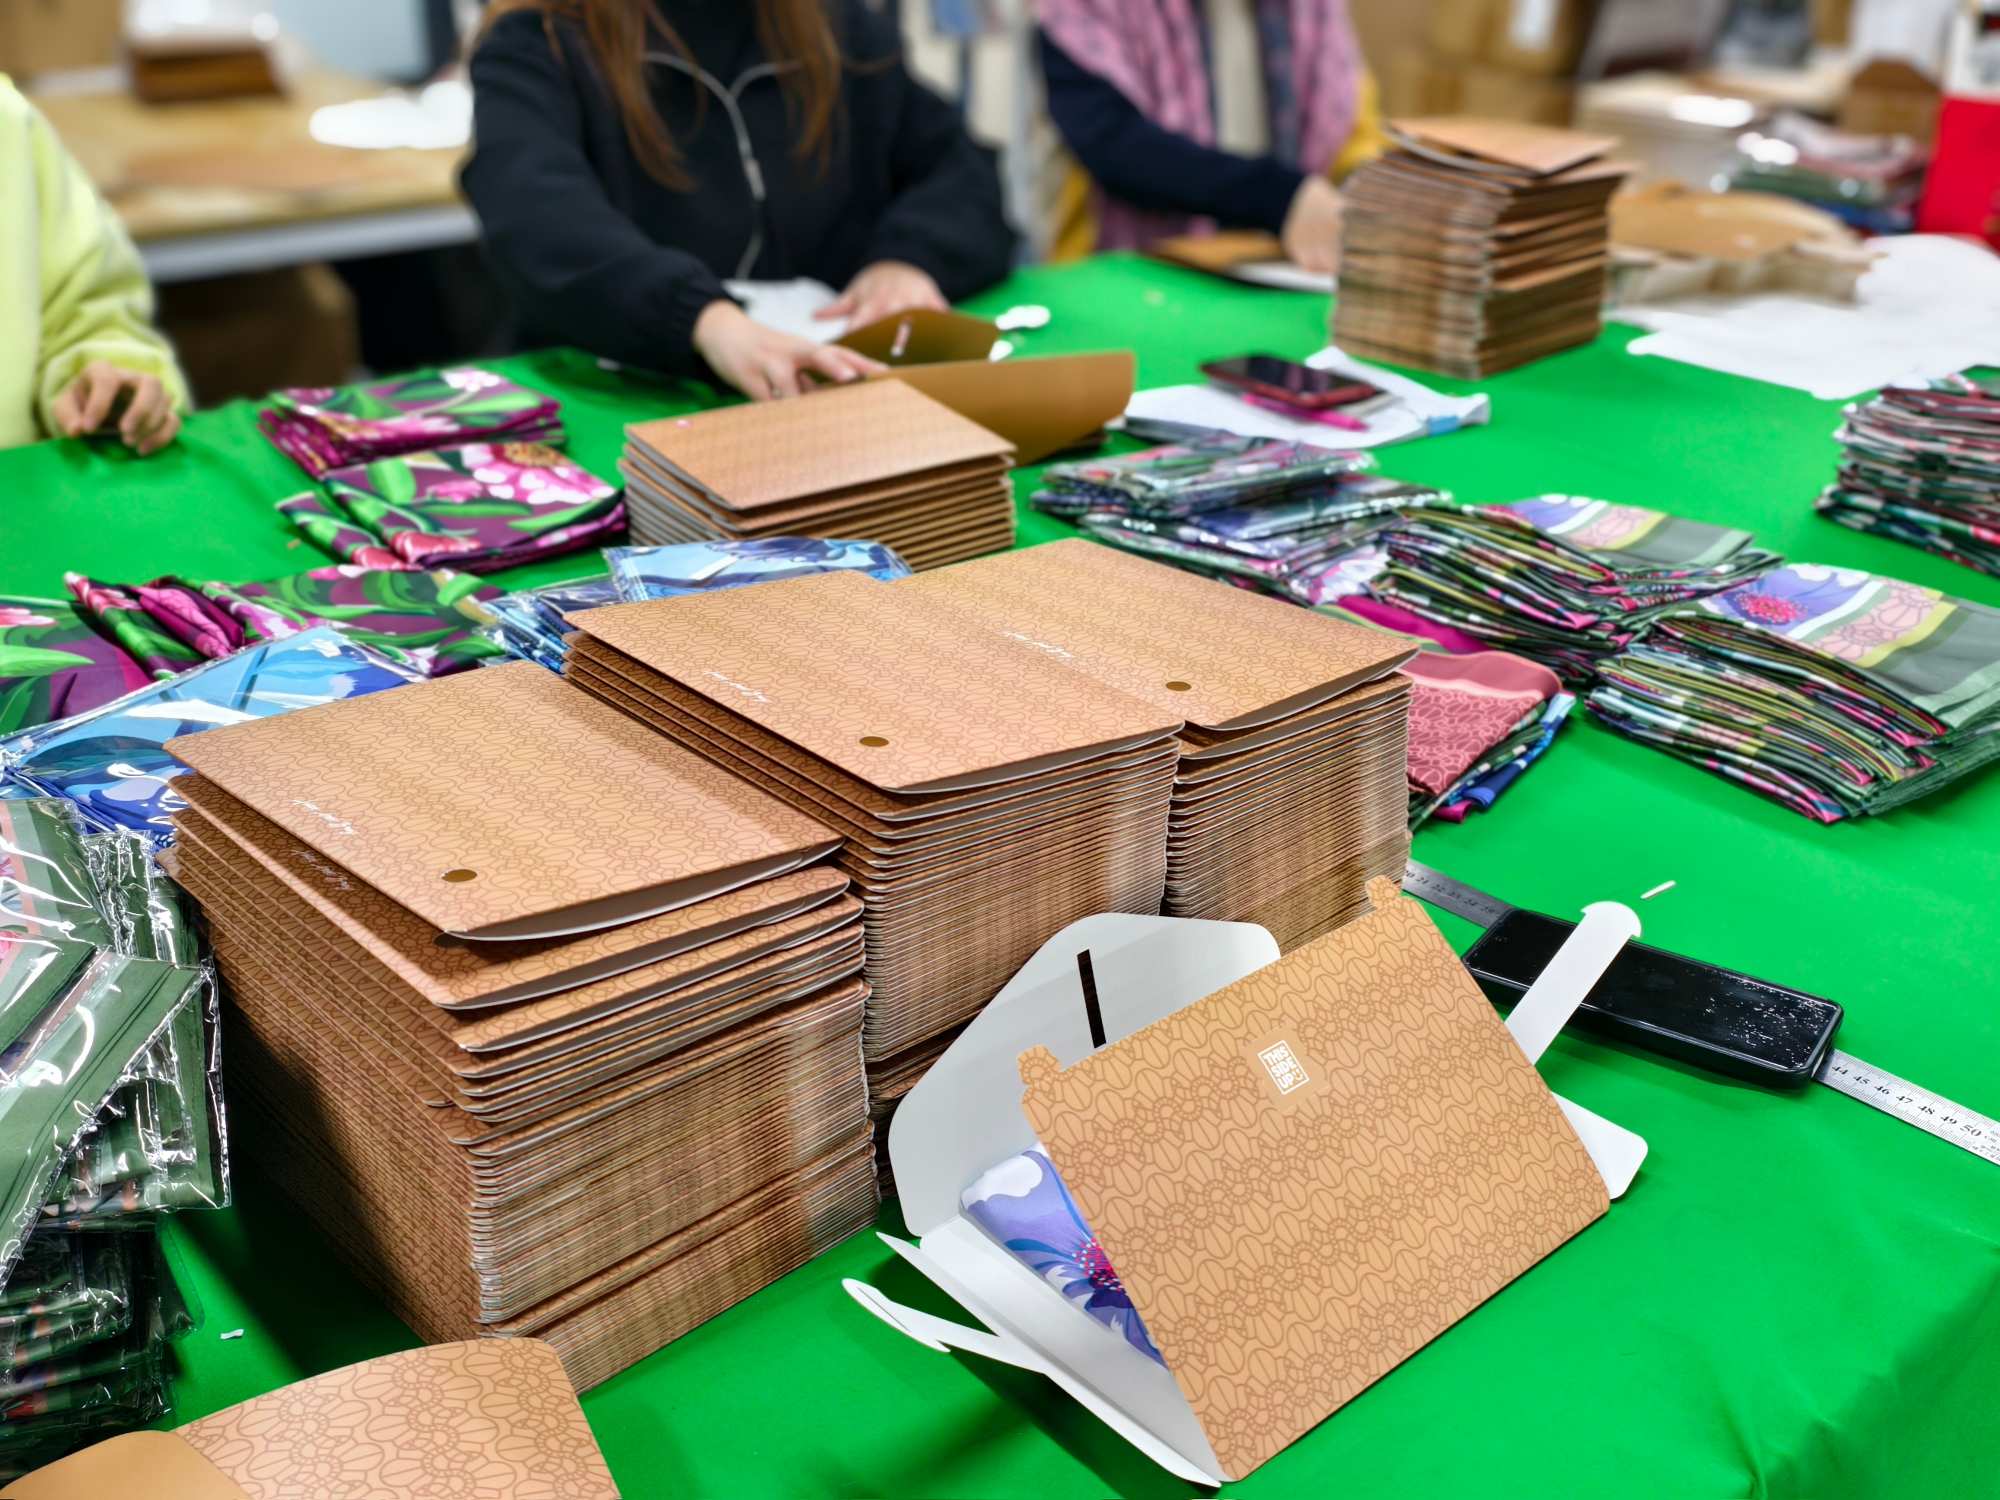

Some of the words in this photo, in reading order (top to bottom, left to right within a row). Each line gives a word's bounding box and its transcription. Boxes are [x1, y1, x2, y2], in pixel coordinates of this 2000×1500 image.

[1262, 1045, 1290, 1066] THIS
[1270, 1055, 1298, 1078] SIDE
[1276, 1071, 1294, 1089] UP
[1831, 1066, 1849, 1076] 44
[1853, 1075, 1871, 1085] 45
[1873, 1085, 1891, 1096] 46
[1895, 1095, 1914, 1105] 47
[1917, 1105, 1936, 1116] 48
[1940, 1115, 1958, 1126] 49
[1959, 1123, 1983, 1138] 50
